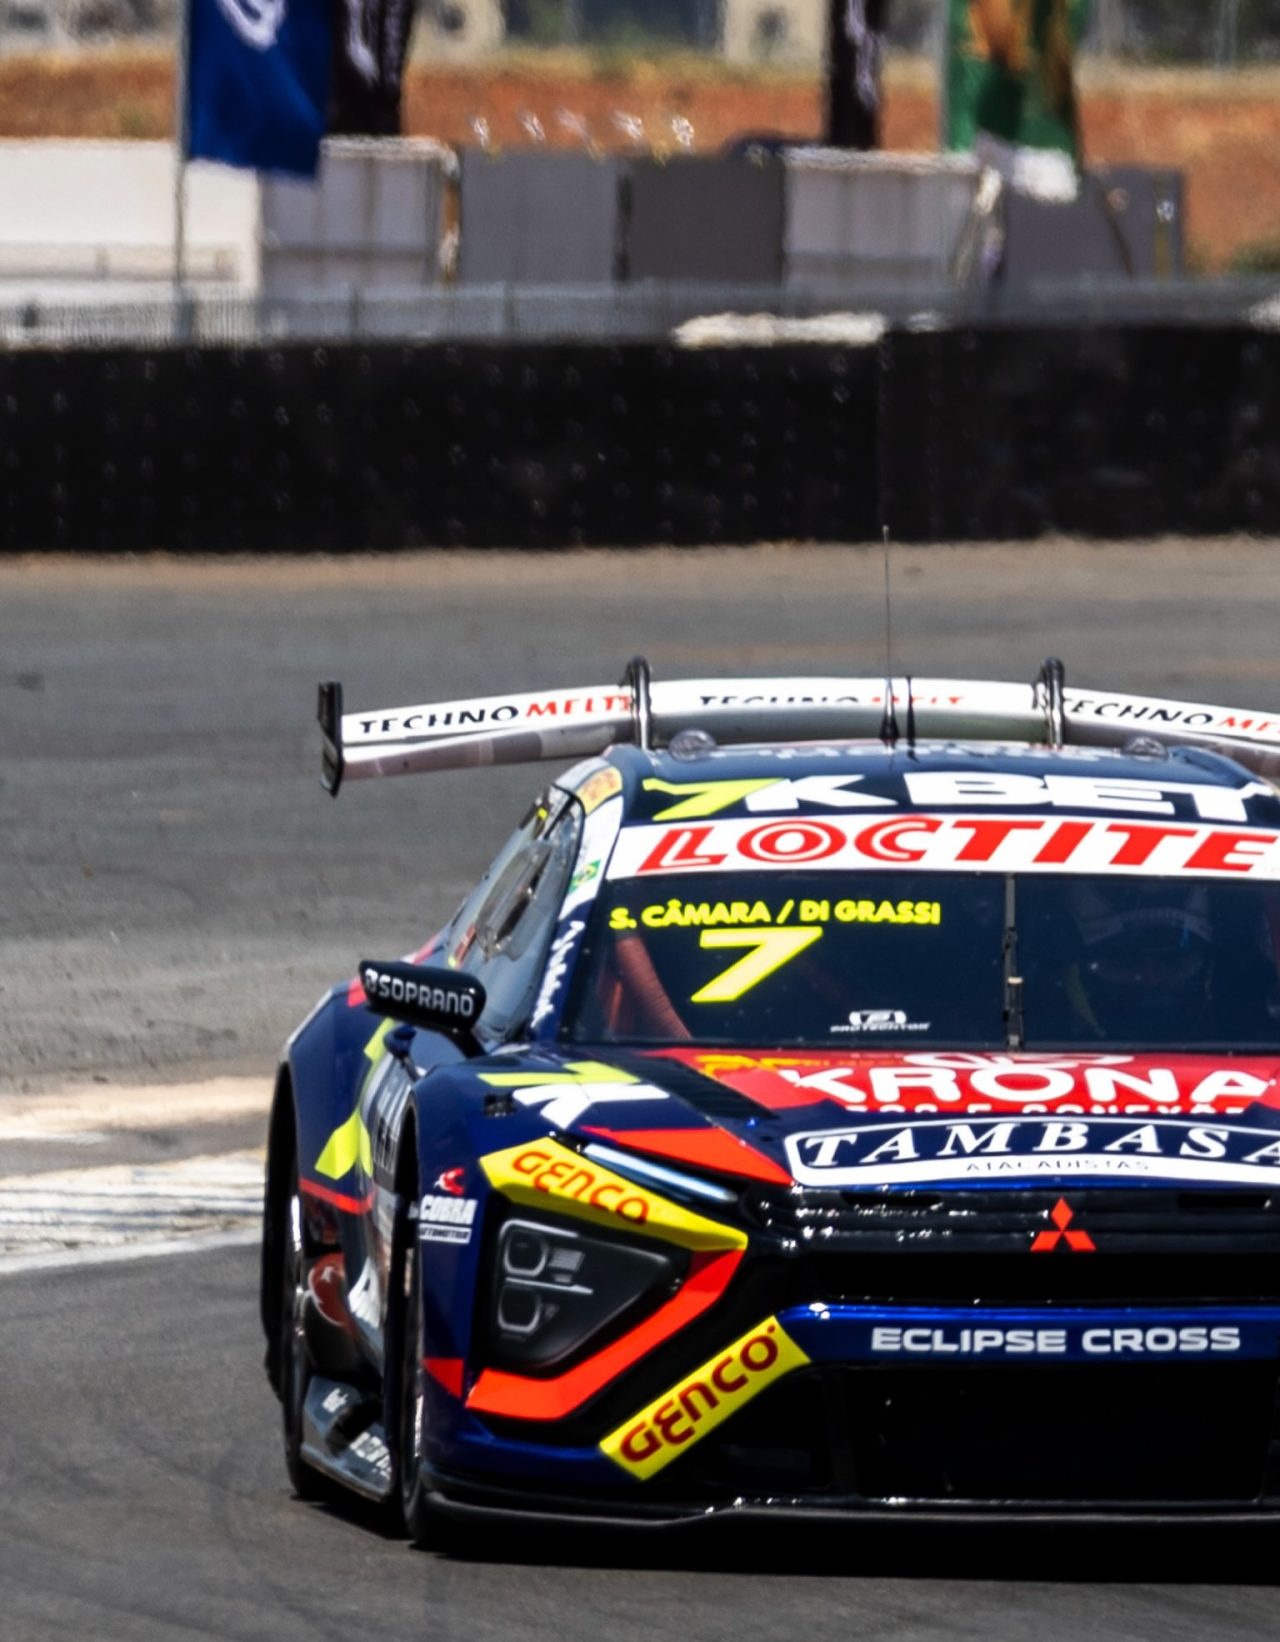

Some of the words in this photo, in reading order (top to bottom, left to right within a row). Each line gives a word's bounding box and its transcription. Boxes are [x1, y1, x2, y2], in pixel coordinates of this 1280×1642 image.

[636, 816, 1279, 875] LOCTITE
[608, 907, 638, 930] S.
[641, 898, 772, 927] CÂMARA
[799, 900, 829, 922] DI
[834, 900, 941, 925] GRASSI
[690, 925, 824, 1003] 7
[378, 975, 474, 1017] SOPRANO
[777, 1066, 1268, 1103] KRONA
[511, 1150, 650, 1226] GENCO
[871, 1327, 1067, 1353] ECLIPSE
[1081, 1327, 1241, 1353] CROSS
[619, 1324, 777, 1463] GENCO
